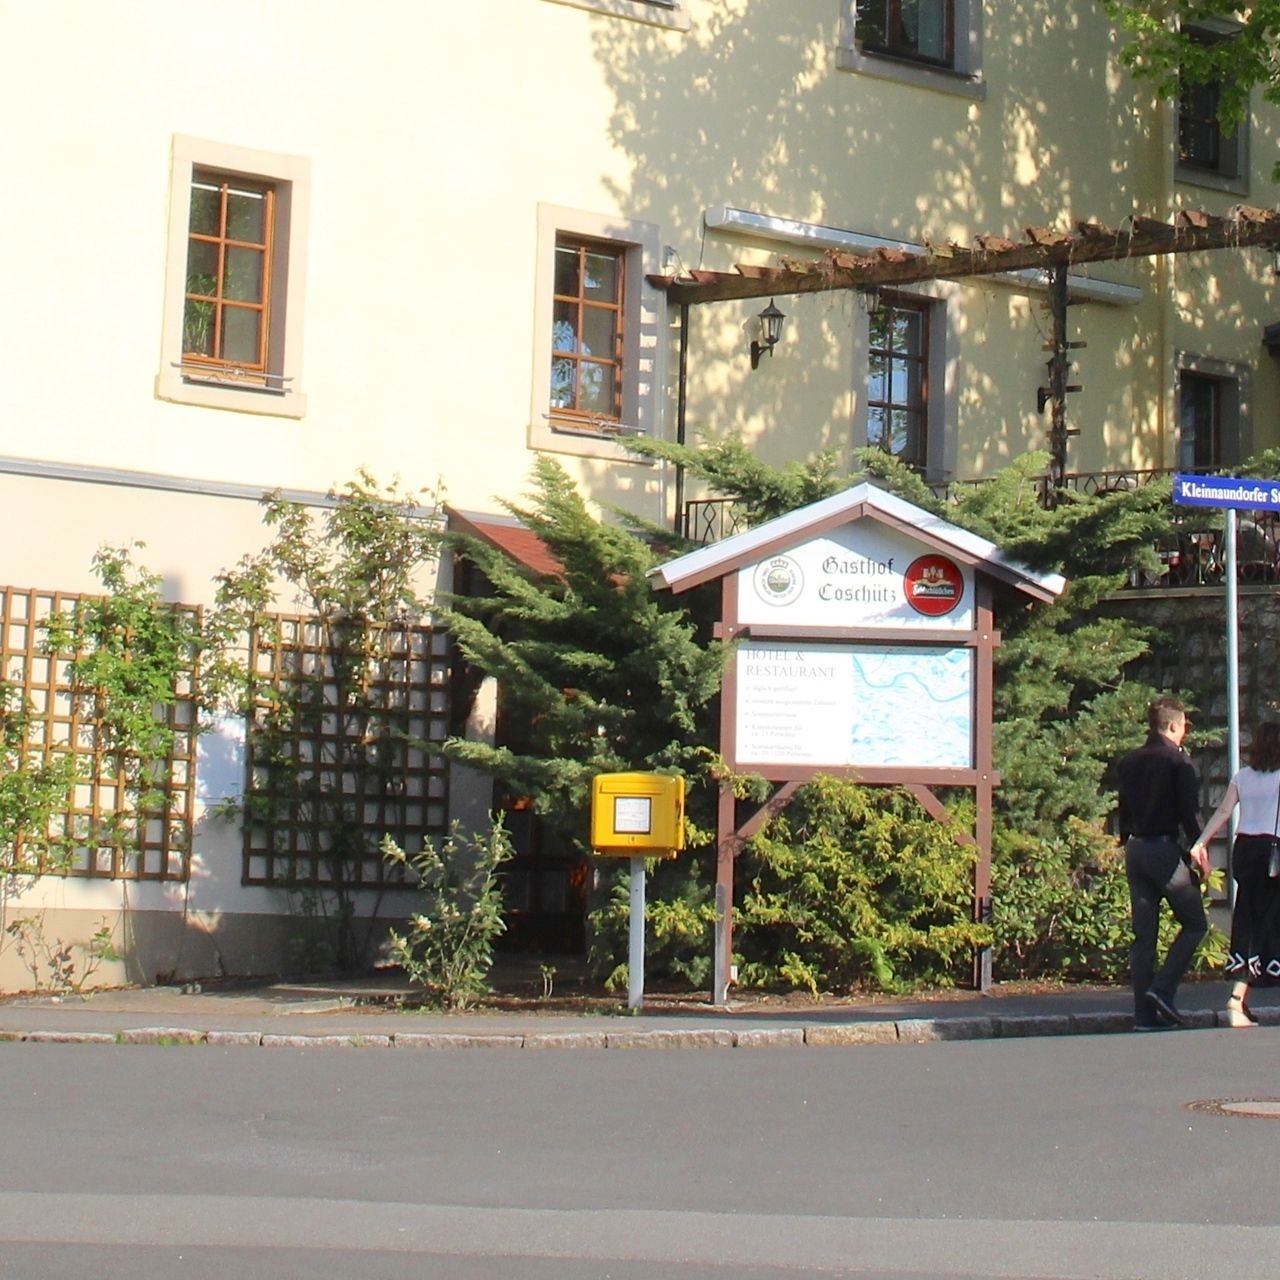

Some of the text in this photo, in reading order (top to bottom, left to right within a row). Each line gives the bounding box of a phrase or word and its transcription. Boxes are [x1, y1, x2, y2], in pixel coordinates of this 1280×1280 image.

[1181, 481, 1268, 503] Kleinnaundorfer
[822, 556, 895, 577] Gasthof
[818, 583, 897, 605] Coschütz
[746, 648, 805, 661] HOTEL &
[746, 664, 837, 678] RESTAURANT
